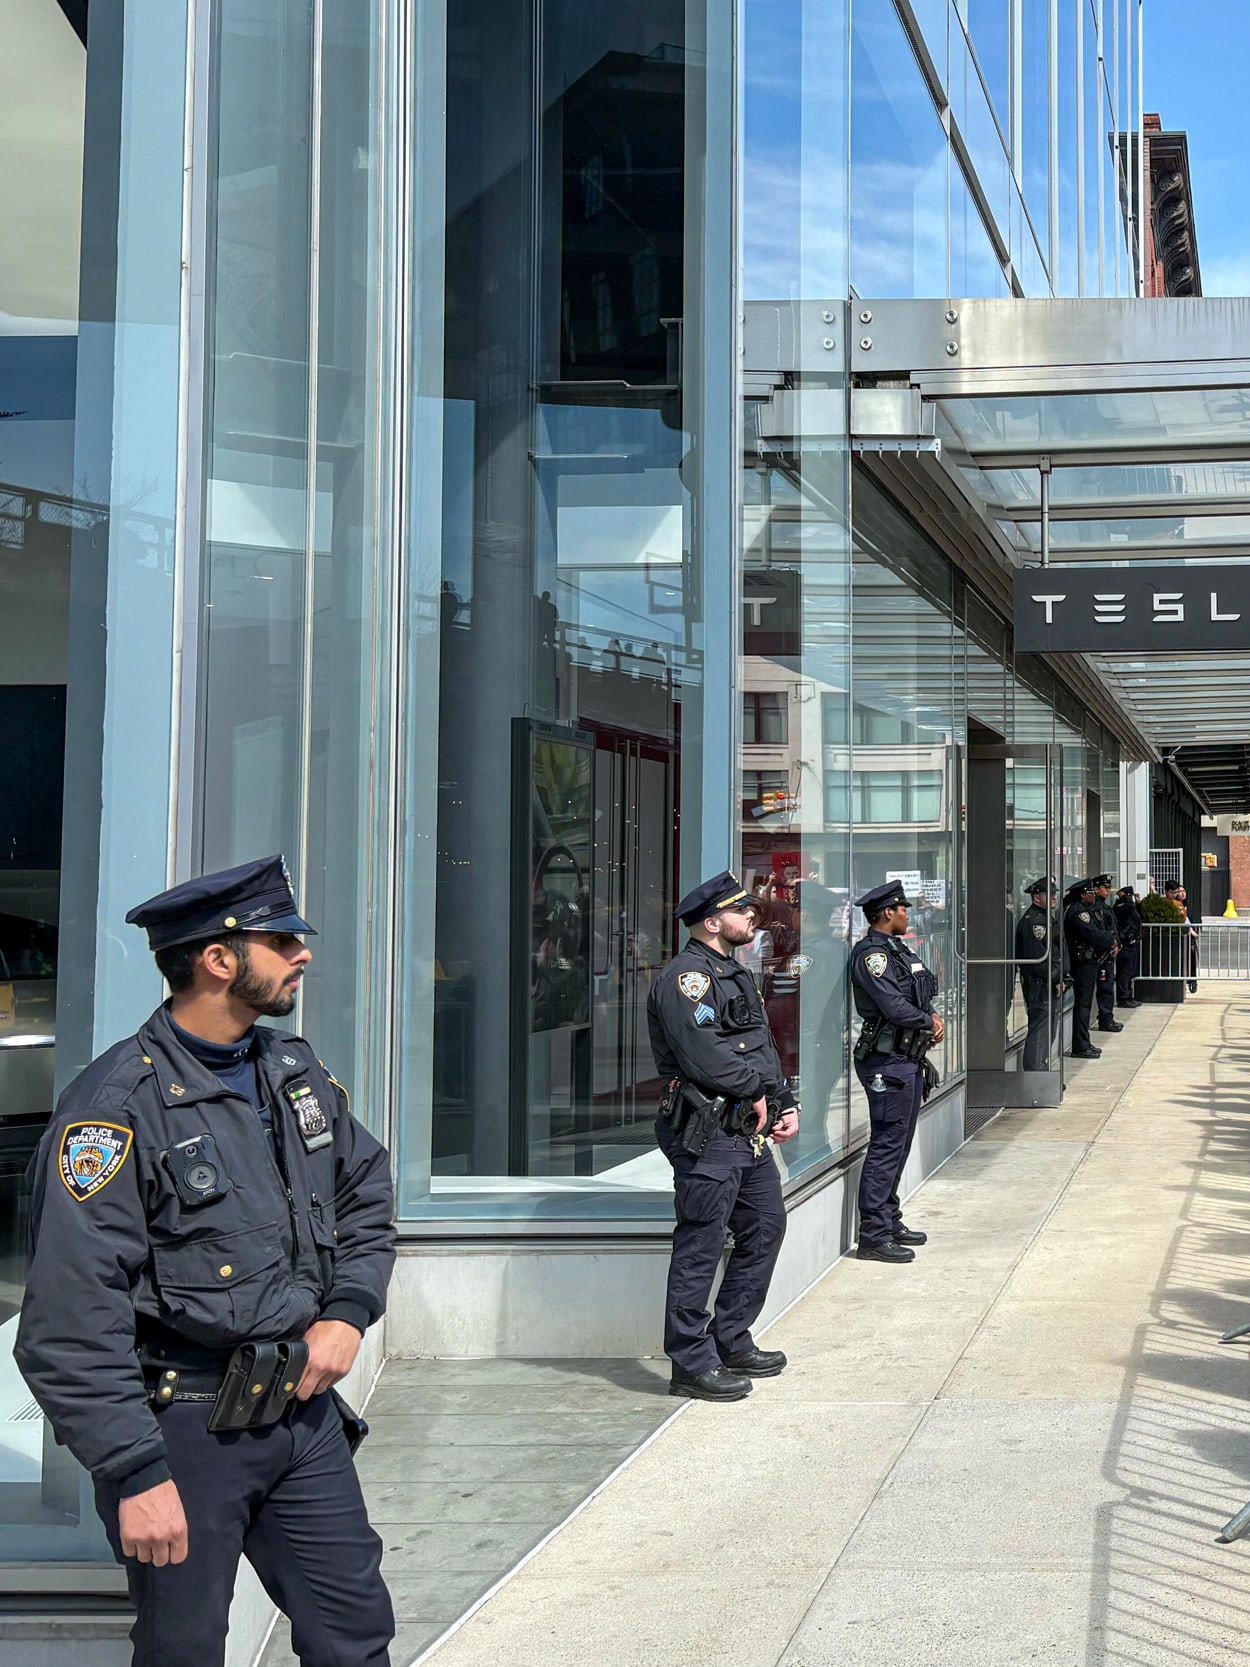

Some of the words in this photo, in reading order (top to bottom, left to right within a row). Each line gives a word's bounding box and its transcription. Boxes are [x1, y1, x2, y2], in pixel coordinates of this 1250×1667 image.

[66, 1136, 124, 1150] DEPARTMENT
[80, 1127, 113, 1138] POLICE
[62, 1155, 70, 1174] CITY
[66, 1175, 76, 1186] OF
[87, 1176, 104, 1192] NEW
[104, 1154, 122, 1176] YORK
